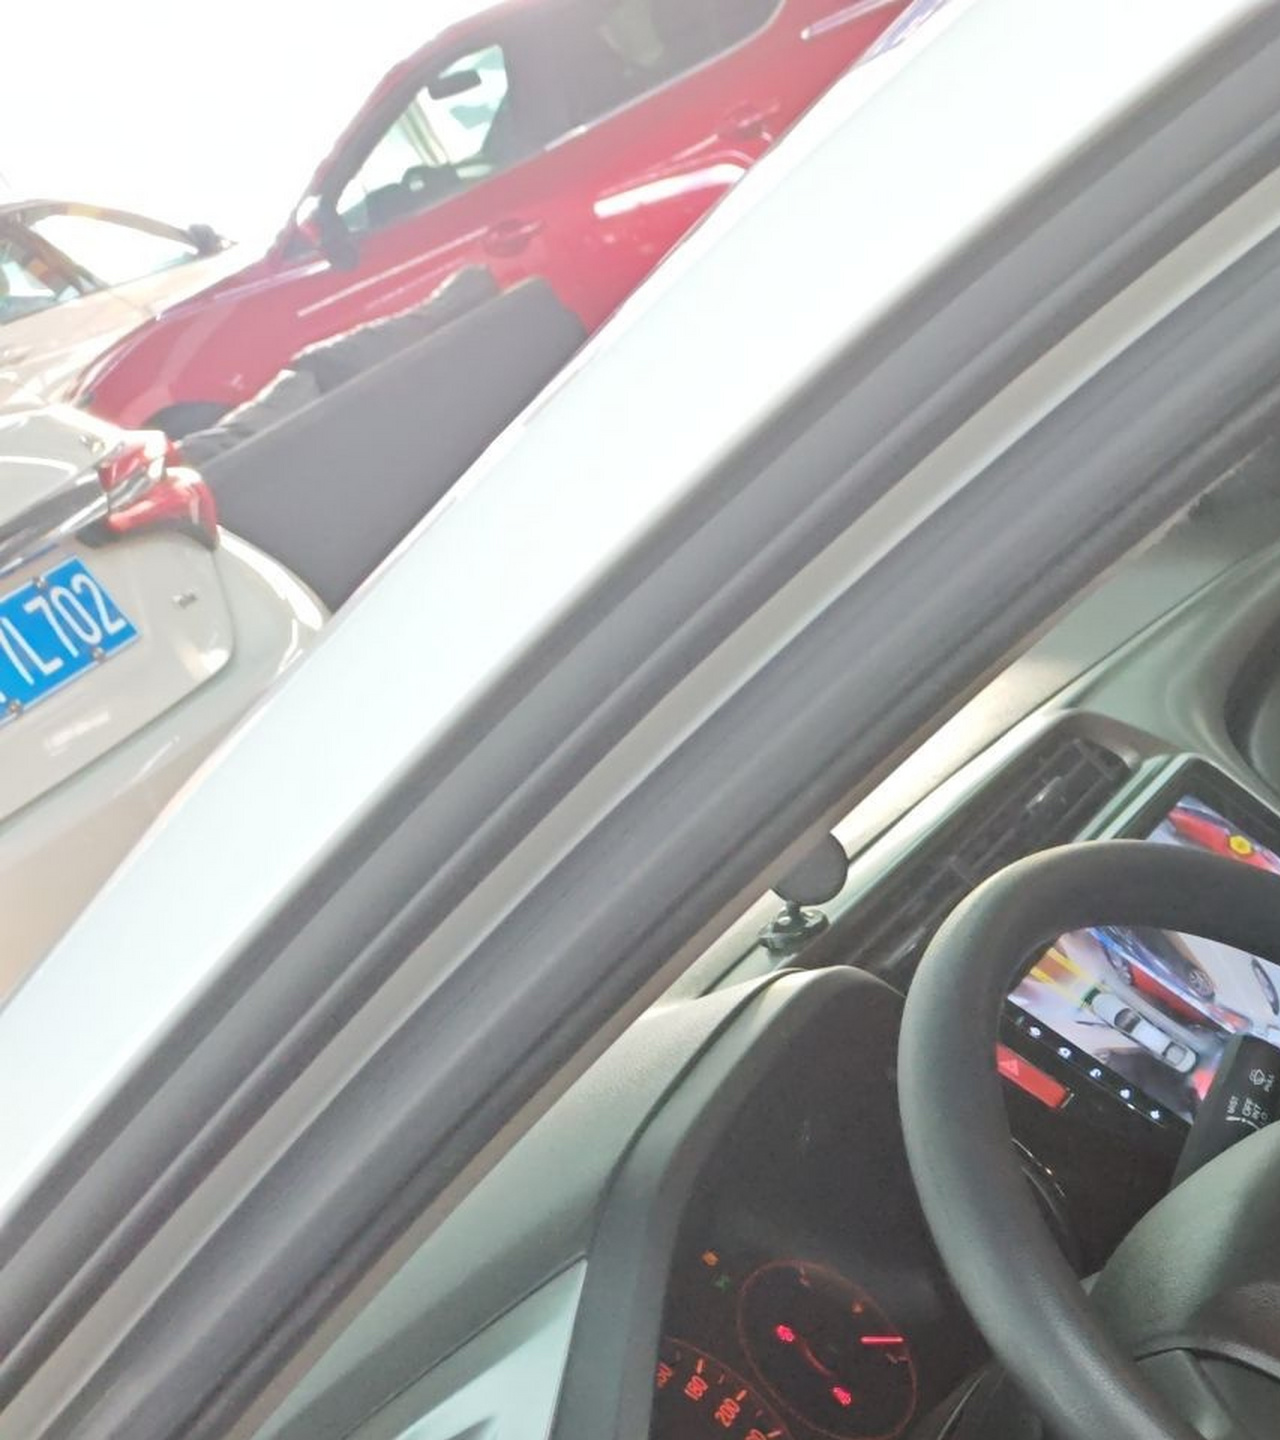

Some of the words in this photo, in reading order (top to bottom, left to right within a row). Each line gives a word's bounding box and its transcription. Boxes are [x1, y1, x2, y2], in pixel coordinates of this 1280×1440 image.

[1241, 1098, 1254, 1117] OFF
[683, 1375, 709, 1401] 180
[714, 1398, 741, 1428] 200
